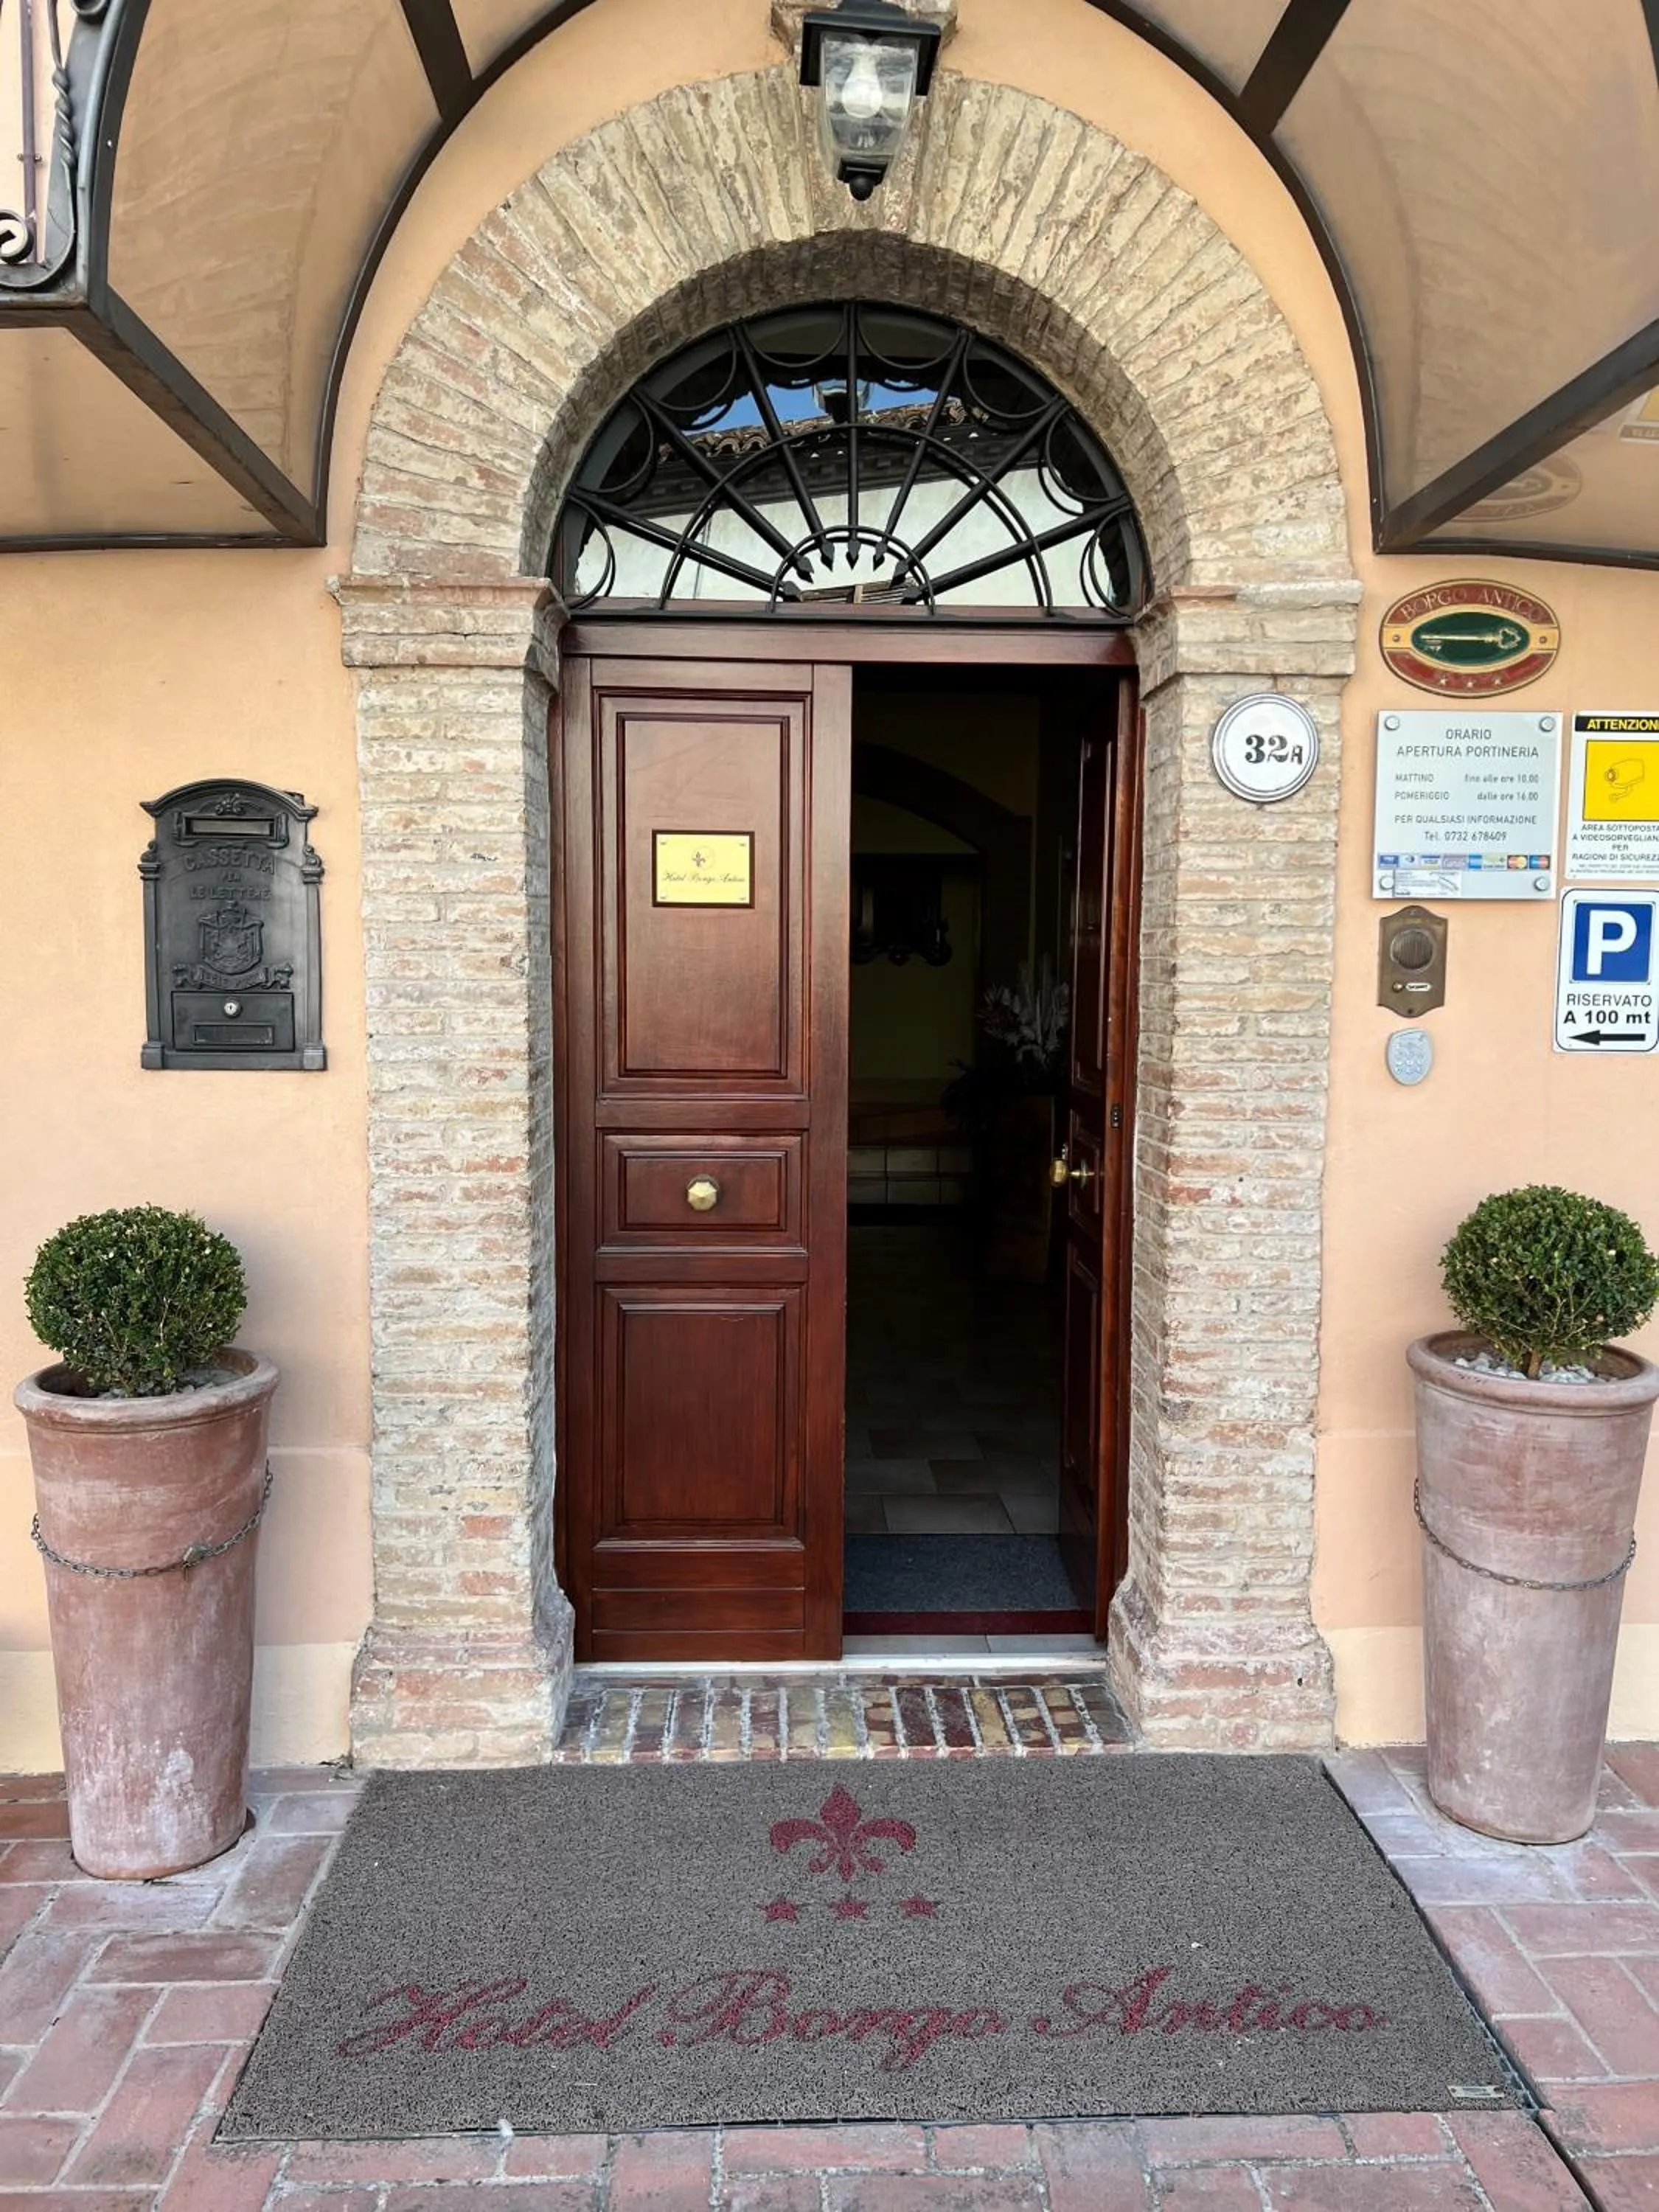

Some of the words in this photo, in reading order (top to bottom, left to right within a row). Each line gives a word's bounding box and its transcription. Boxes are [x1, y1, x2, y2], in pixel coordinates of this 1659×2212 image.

[1400, 588, 1467, 621] BORGO
[1477, 588, 1543, 622] ANTICO
[1587, 719, 1659, 731] ATTENZION
[1445, 728, 1492, 740] ORARIO
[1397, 745, 1462, 757] APERTURA
[1466, 745, 1540, 758] PORTINERIA
[1395, 773, 1434, 782] MATTINO
[1500, 775, 1514, 783] ore
[1394, 791, 1450, 801] POMERIGGIO
[1477, 790, 1498, 801] dalle
[1500, 793, 1514, 801] ore
[1394, 815, 1413, 824] PER
[1415, 815, 1465, 824] QUALSIASI
[1467, 815, 1537, 825] INFORMAZIONE
[1582, 824, 1604, 832] AREA
[1444, 831, 1467, 841] 0732
[1580, 833, 1659, 842] VIDEOSORVEGLIAN
[184, 848, 276, 875] CASSETTA
[1571, 853, 1607, 861] RAGIONI
[1609, 853, 1618, 861] DI
[1587, 909, 1638, 975] P
[1566, 993, 1652, 1007] RISERVATO
[1563, 1009, 1576, 1024] A
[1585, 1009, 1618, 1024] 100
[1626, 1010, 1651, 1024] mt
[333, 1976, 658, 2059] Hotel
[660, 1965, 1006, 2070] Borgo
[1034, 1964, 1389, 2039] Antico
